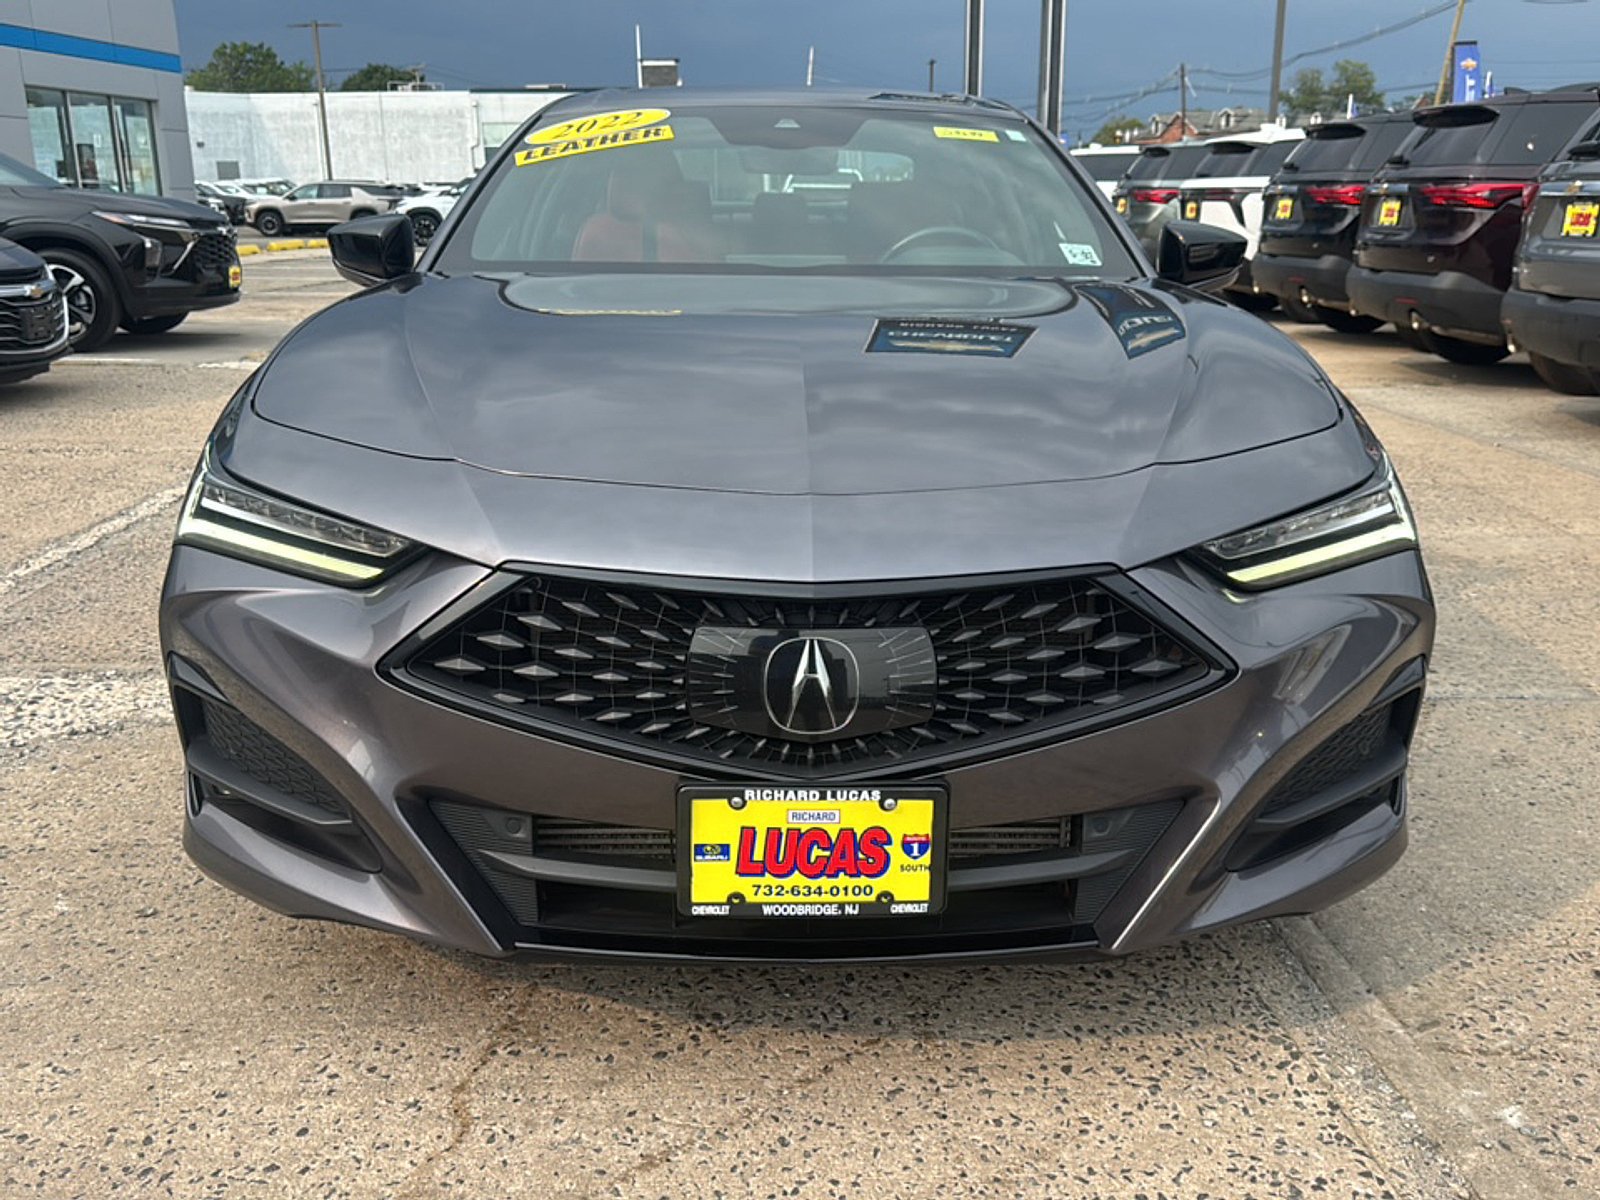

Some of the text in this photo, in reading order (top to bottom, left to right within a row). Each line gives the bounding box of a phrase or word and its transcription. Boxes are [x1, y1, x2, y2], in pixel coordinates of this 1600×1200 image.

[552, 112, 643, 139] 2022
[523, 128, 667, 161] LEATHER
[744, 789, 881, 801] RICHARD LUCAS
[791, 811, 836, 822] RICHARD
[736, 825, 893, 879] LUCAS
[910, 842, 921, 857] 1
[900, 864, 932, 872] SOUTH
[752, 884, 874, 897] 732-634-0100
[844, 904, 860, 915] NJ
